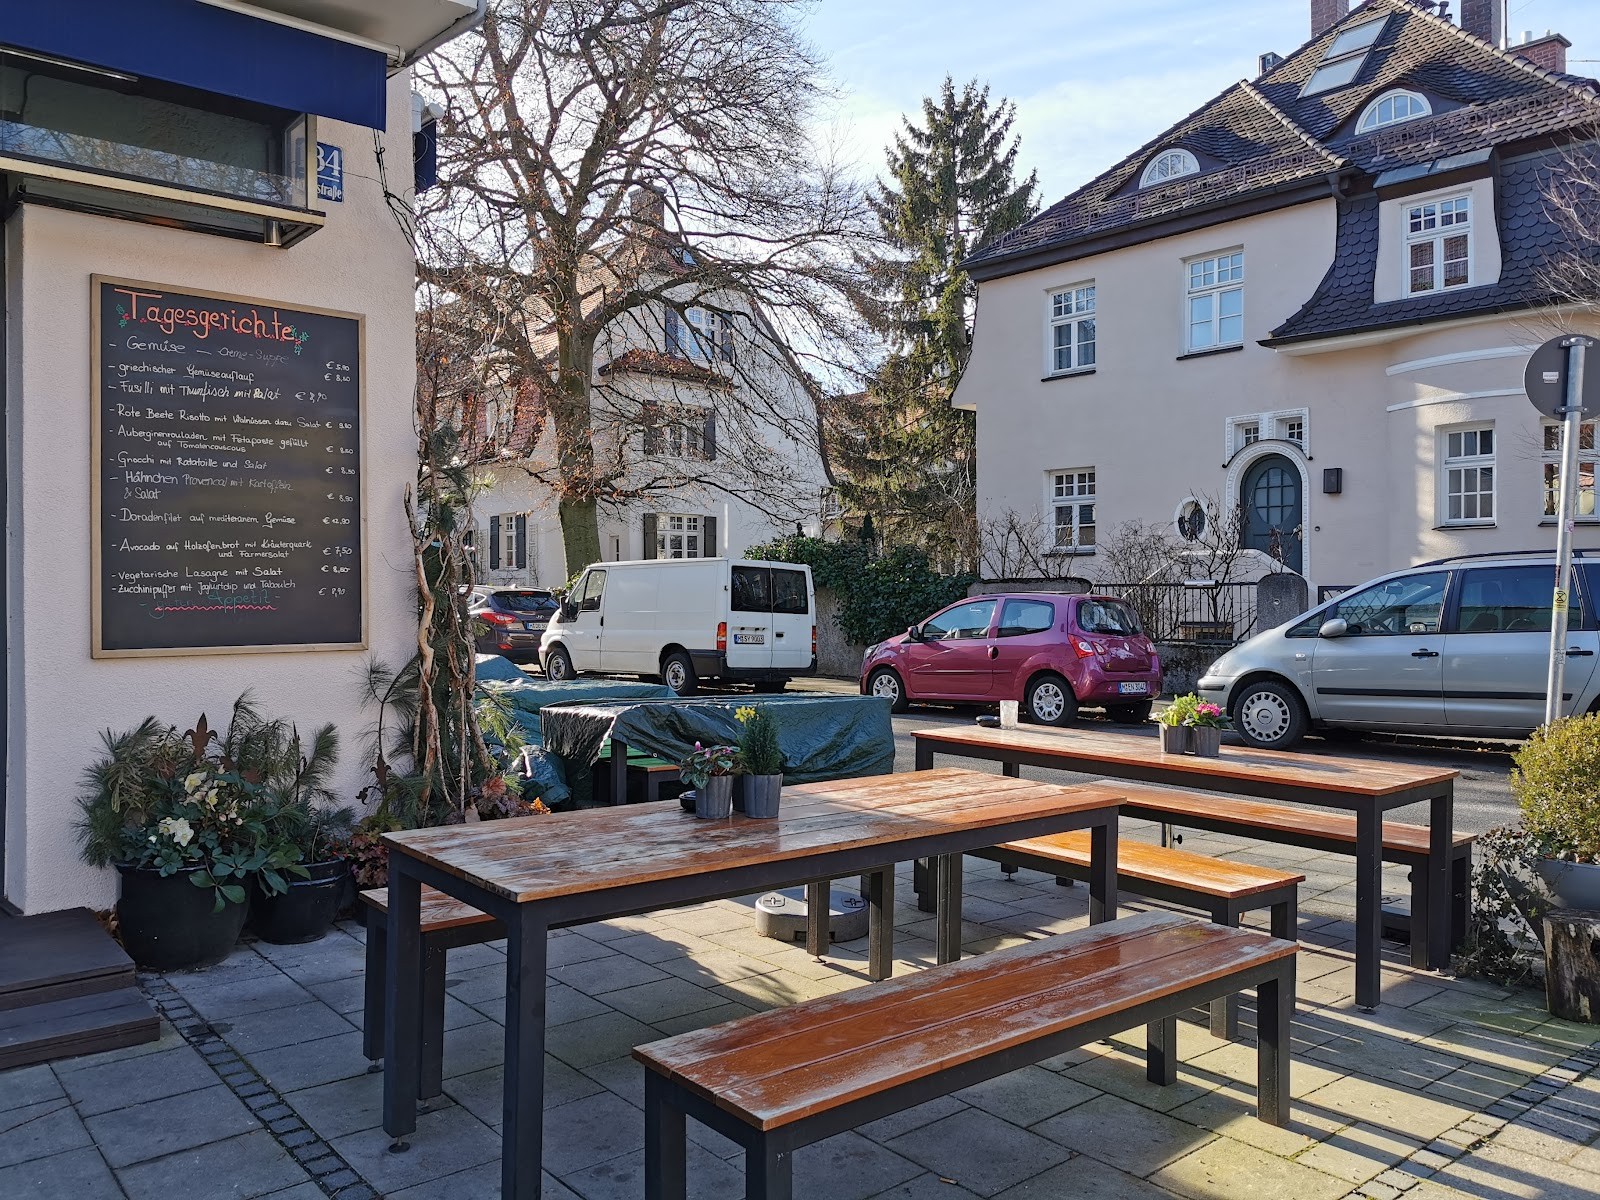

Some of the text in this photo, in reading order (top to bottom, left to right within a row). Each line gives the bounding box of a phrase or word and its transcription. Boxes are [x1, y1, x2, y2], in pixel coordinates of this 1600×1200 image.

[114, 288, 296, 340] Tagesgerichte
[126, 335, 187, 354] Gemüse
[117, 361, 176, 377] griechischer
[120, 380, 155, 394] Fusilli
[160, 384, 175, 395] mit
[179, 381, 230, 402] Thunfisch
[295, 391, 306, 400] €
[116, 403, 141, 417] Rote
[145, 407, 174, 420] Beete
[179, 409, 211, 421] Risotto
[232, 414, 272, 425] Walnüssen
[296, 416, 321, 428] Salat
[117, 424, 208, 441] Auberginenrouladen
[279, 437, 309, 449] gefüllt
[157, 440, 173, 449] auf
[117, 450, 155, 468] Gnocchi
[160, 457, 172, 465] mit
[222, 460, 238, 468] und
[243, 459, 268, 470] Salat
[125, 470, 179, 485] Hähnchen
[230, 477, 243, 487] mit
[134, 486, 161, 499] Salat
[119, 507, 183, 524] Doradenfilet
[189, 512, 206, 524] auf
[262, 511, 297, 529] Gemüse
[119, 537, 161, 552] Avocado
[166, 541, 180, 552] auf
[261, 538, 312, 551] Kräuterquark
[218, 550, 234, 558] und
[239, 550, 290, 558] Farmersalat
[185, 566, 229, 582] Lasagne
[235, 567, 249, 576] mit
[252, 566, 283, 577] Salat
[117, 583, 176, 600] Zucchinipuffer
[180, 582, 193, 592] mit
[243, 582, 256, 590] und
